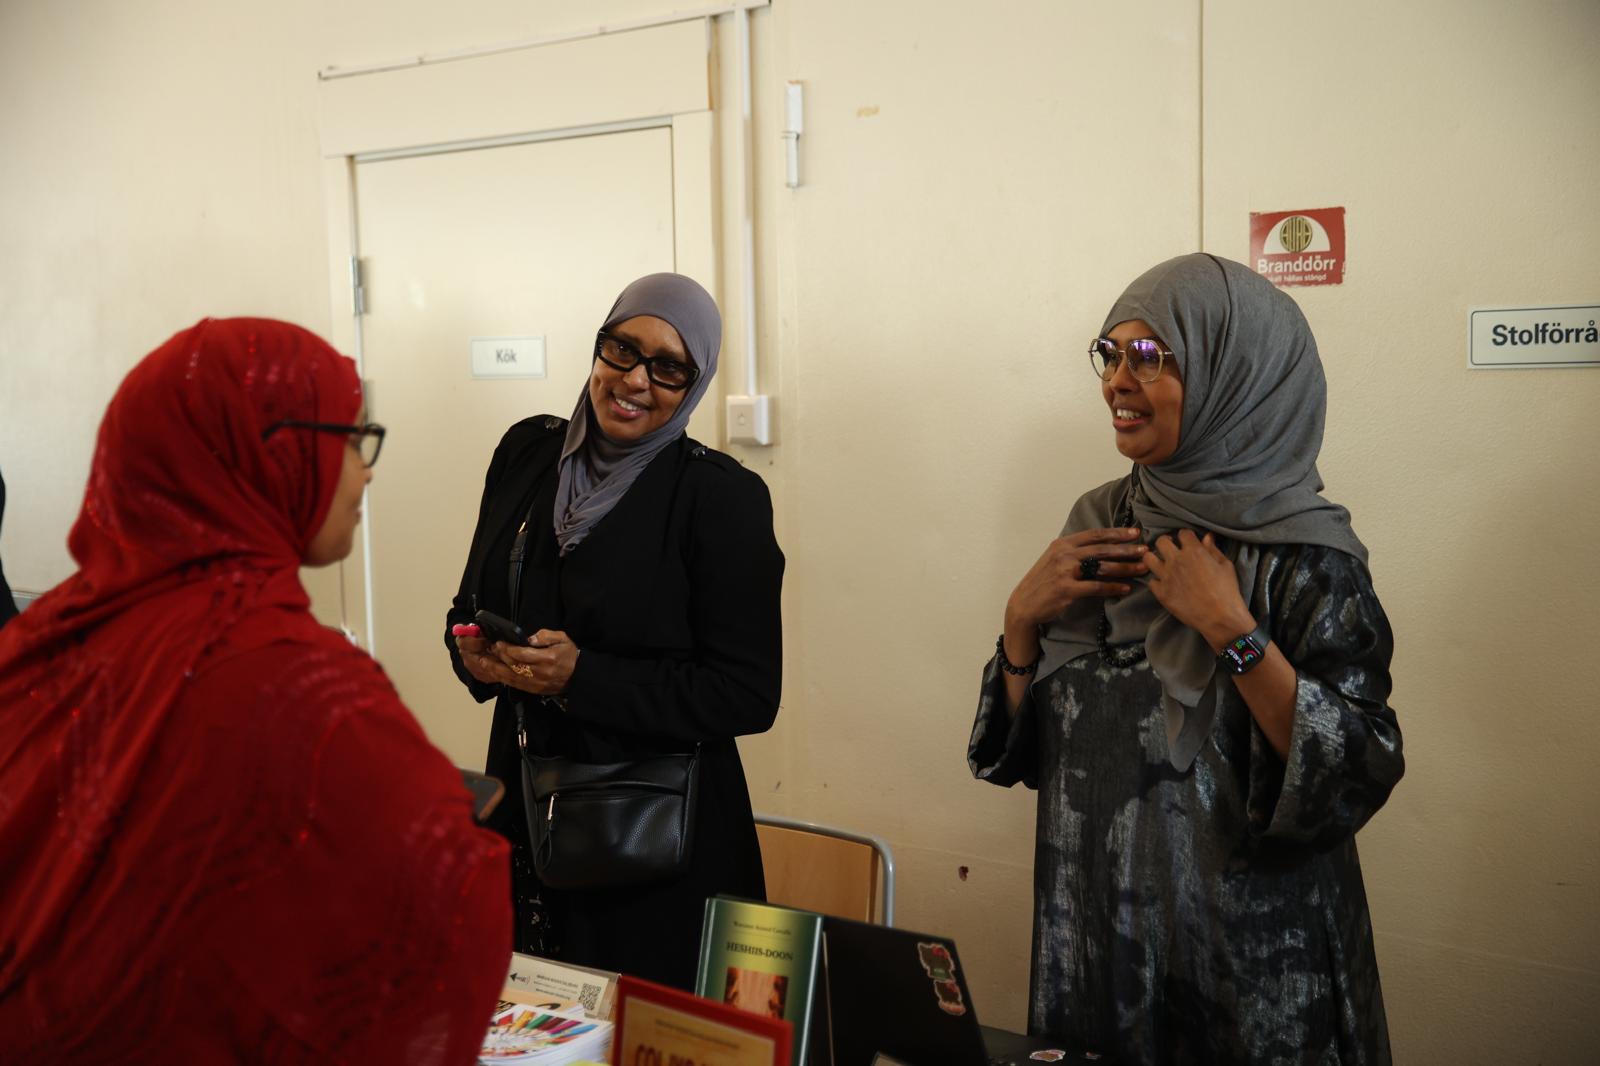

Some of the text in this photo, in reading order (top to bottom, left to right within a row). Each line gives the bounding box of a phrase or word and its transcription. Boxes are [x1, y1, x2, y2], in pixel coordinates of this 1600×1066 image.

[1257, 255, 1336, 273] Branddörr
[1492, 320, 1600, 346] Stolförrå
[496, 348, 517, 364] Kök
